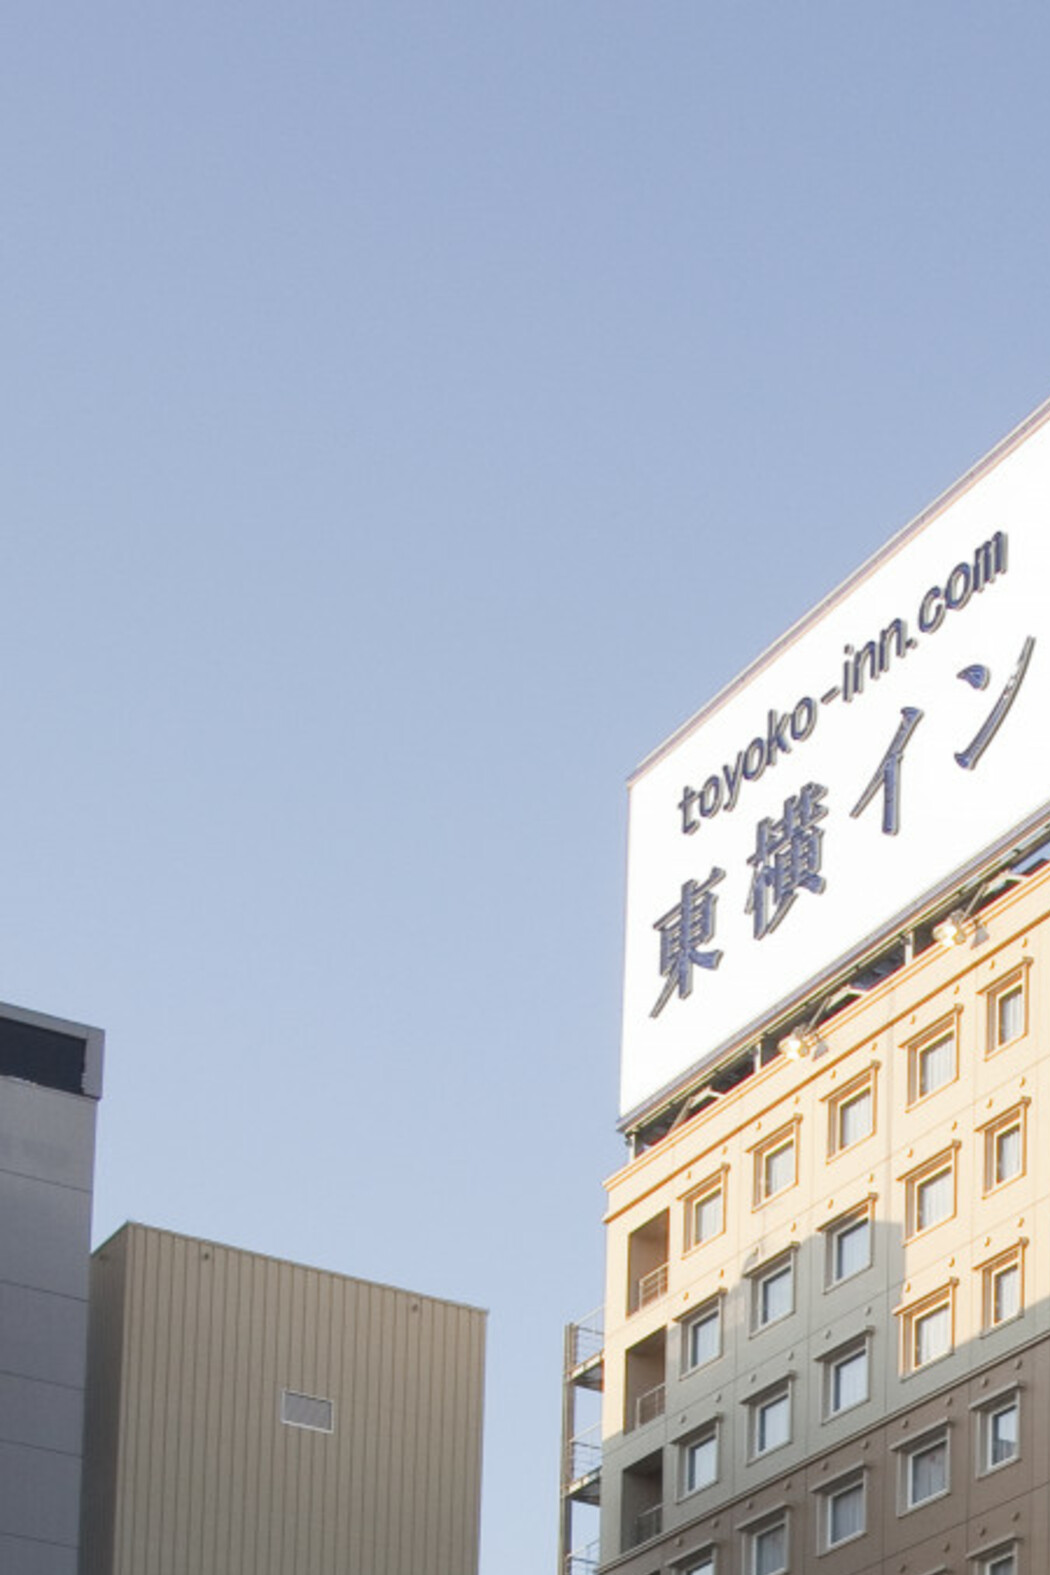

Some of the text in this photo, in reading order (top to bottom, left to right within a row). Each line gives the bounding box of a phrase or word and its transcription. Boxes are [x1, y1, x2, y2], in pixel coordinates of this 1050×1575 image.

[650, 635, 1036, 1018] 東横イン
[678, 530, 1008, 835] toyoko-inn.com
